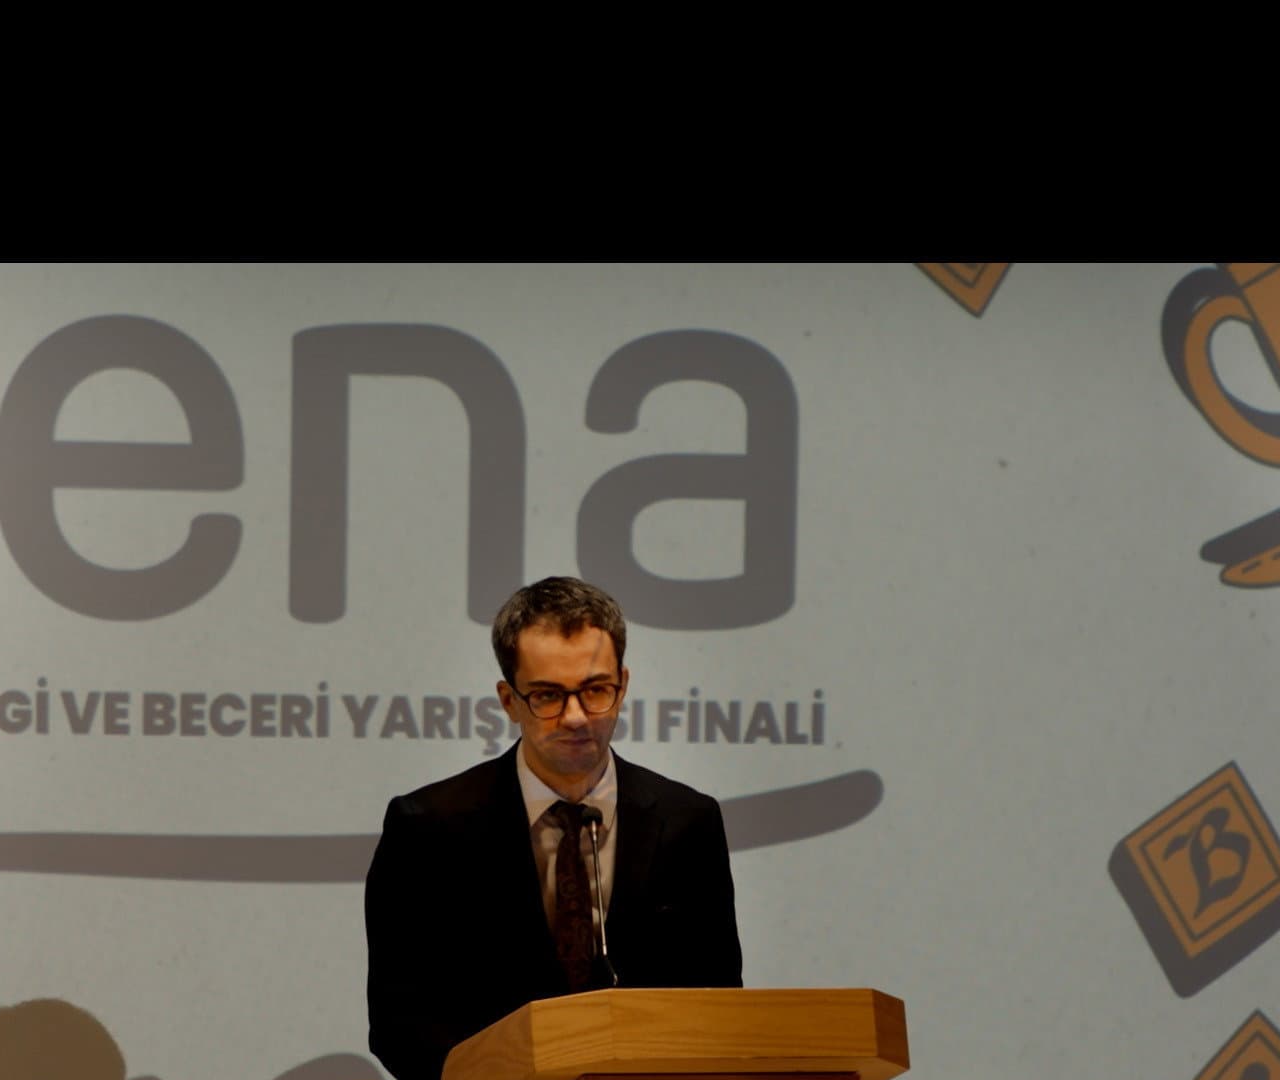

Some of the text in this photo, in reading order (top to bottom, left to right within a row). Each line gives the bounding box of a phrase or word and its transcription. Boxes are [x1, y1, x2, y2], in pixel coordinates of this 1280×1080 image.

[60, 690, 132, 736] VE
[141, 682, 330, 738] BECERİ
[657, 688, 826, 746] FİNALİ
